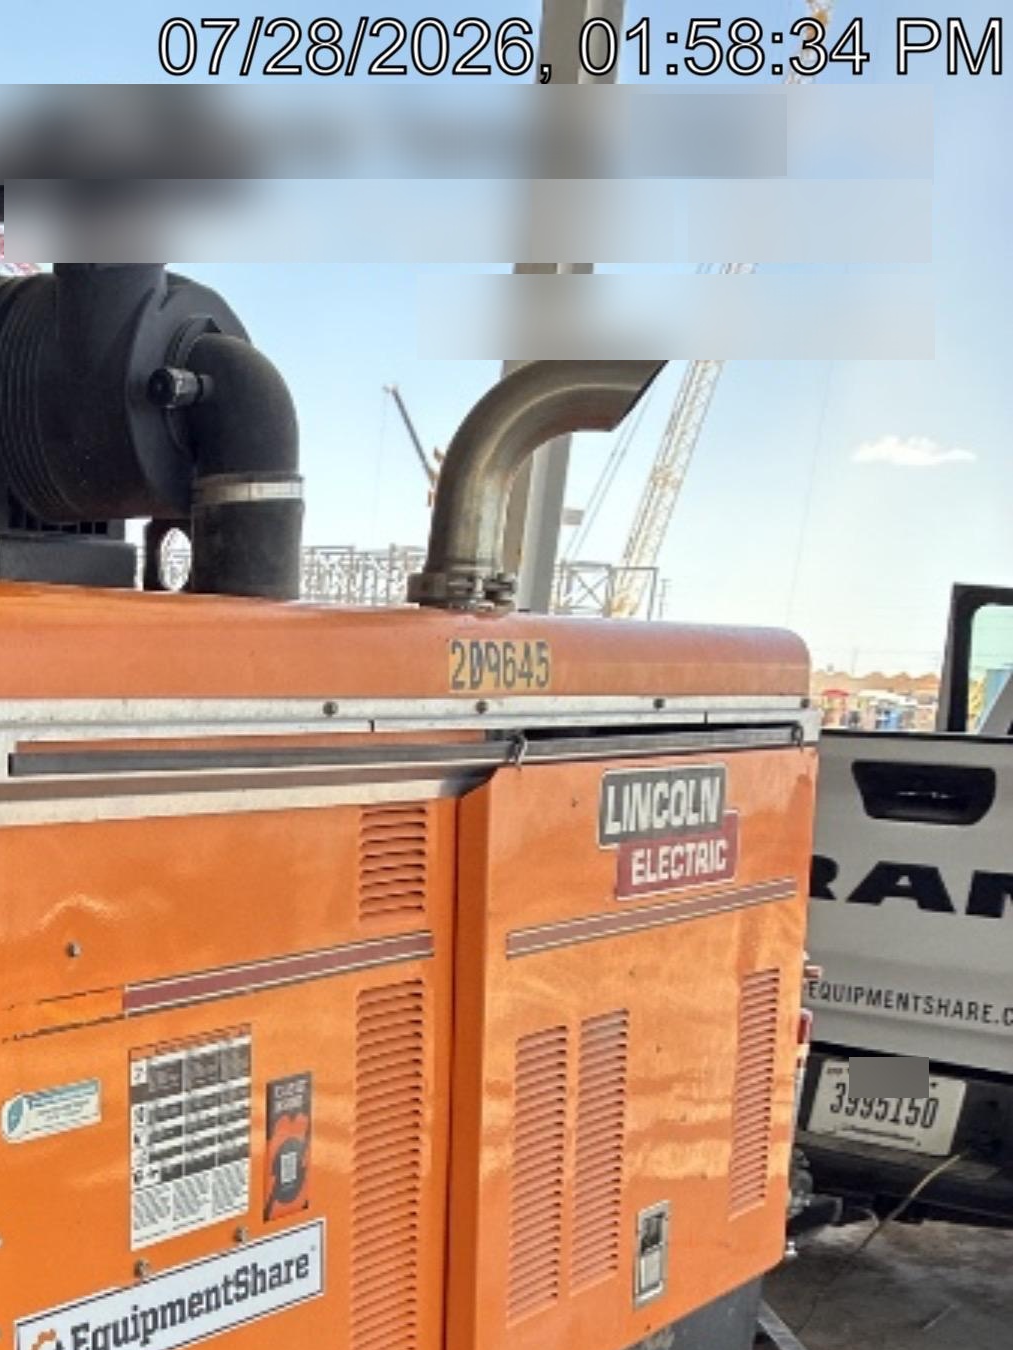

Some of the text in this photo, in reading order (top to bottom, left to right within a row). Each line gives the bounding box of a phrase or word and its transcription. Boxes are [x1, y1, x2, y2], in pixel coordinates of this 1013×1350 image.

[450, 640, 550, 690] 209645
[604, 776, 721, 835] LINCOLN
[631, 839, 728, 886] ELECTRIC
